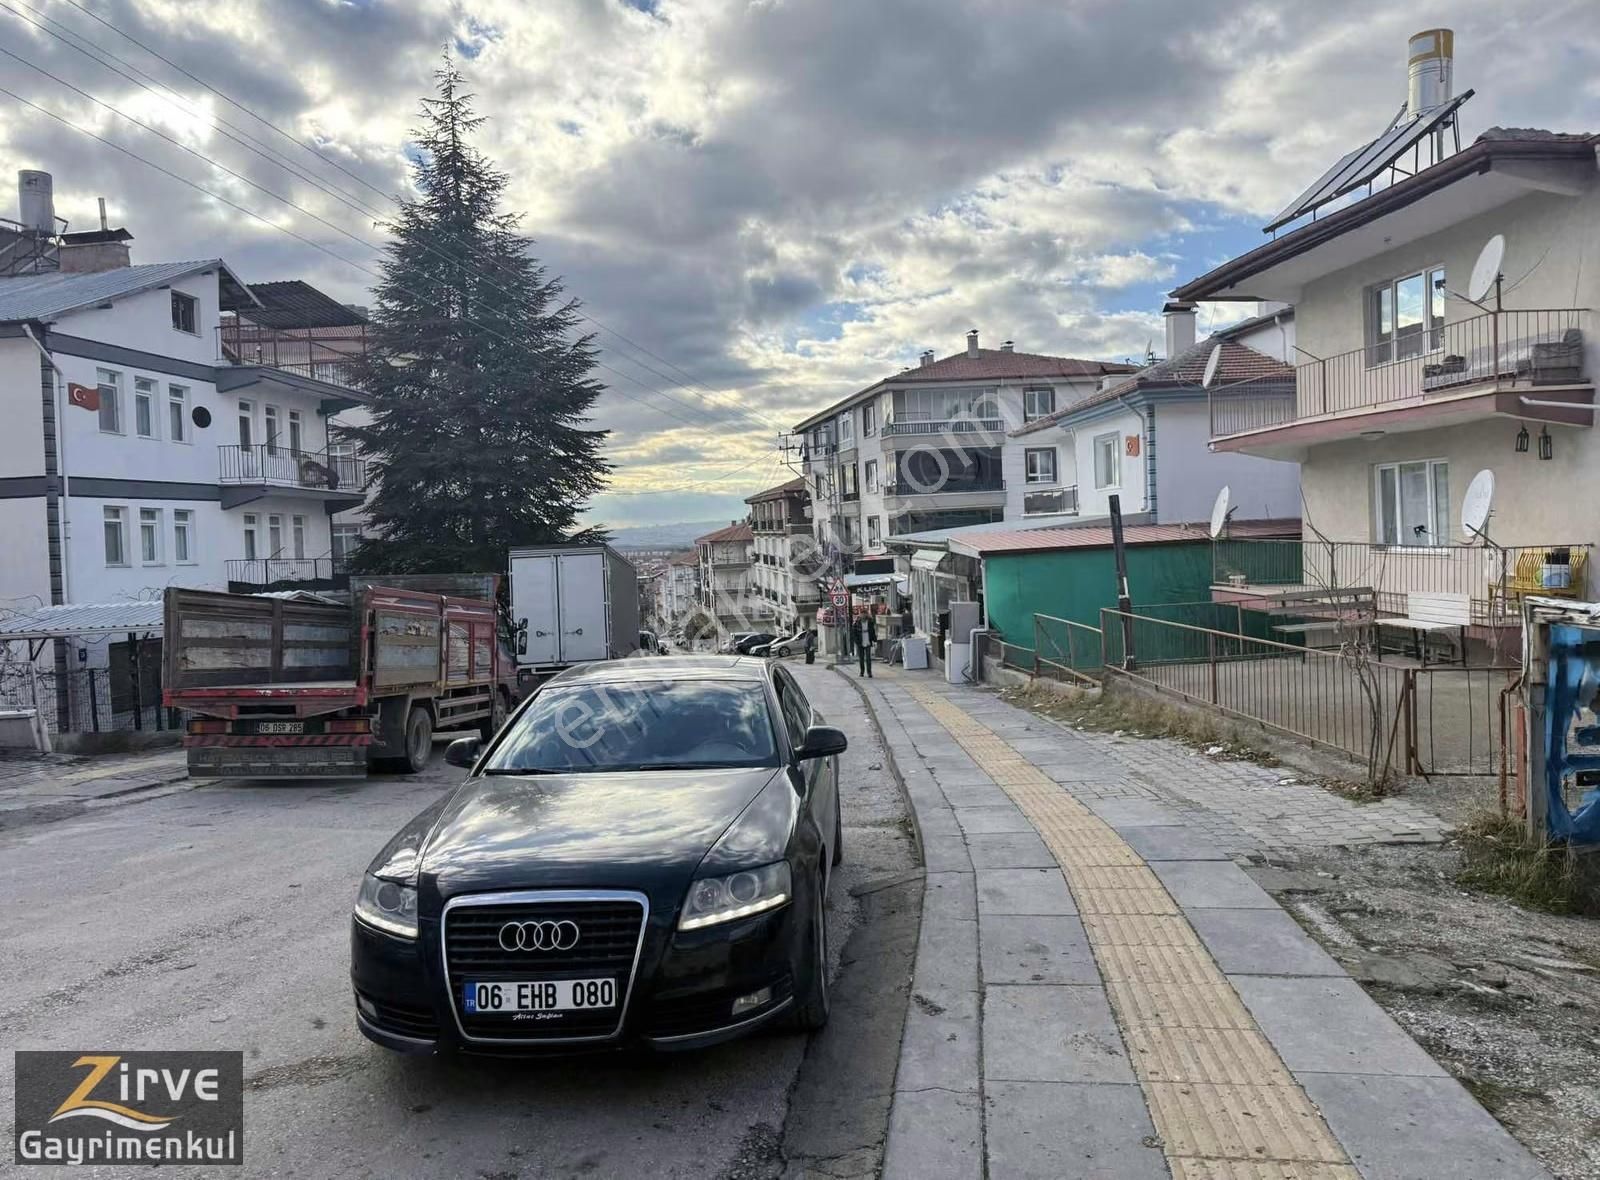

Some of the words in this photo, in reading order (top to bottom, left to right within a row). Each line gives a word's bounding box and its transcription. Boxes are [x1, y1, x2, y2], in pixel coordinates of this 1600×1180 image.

[835, 596, 844, 605] 30
[465, 999, 475, 1008] TR
[477, 984, 503, 1010] 06
[517, 983, 557, 1009] EHB
[572, 980, 613, 1007] 080
